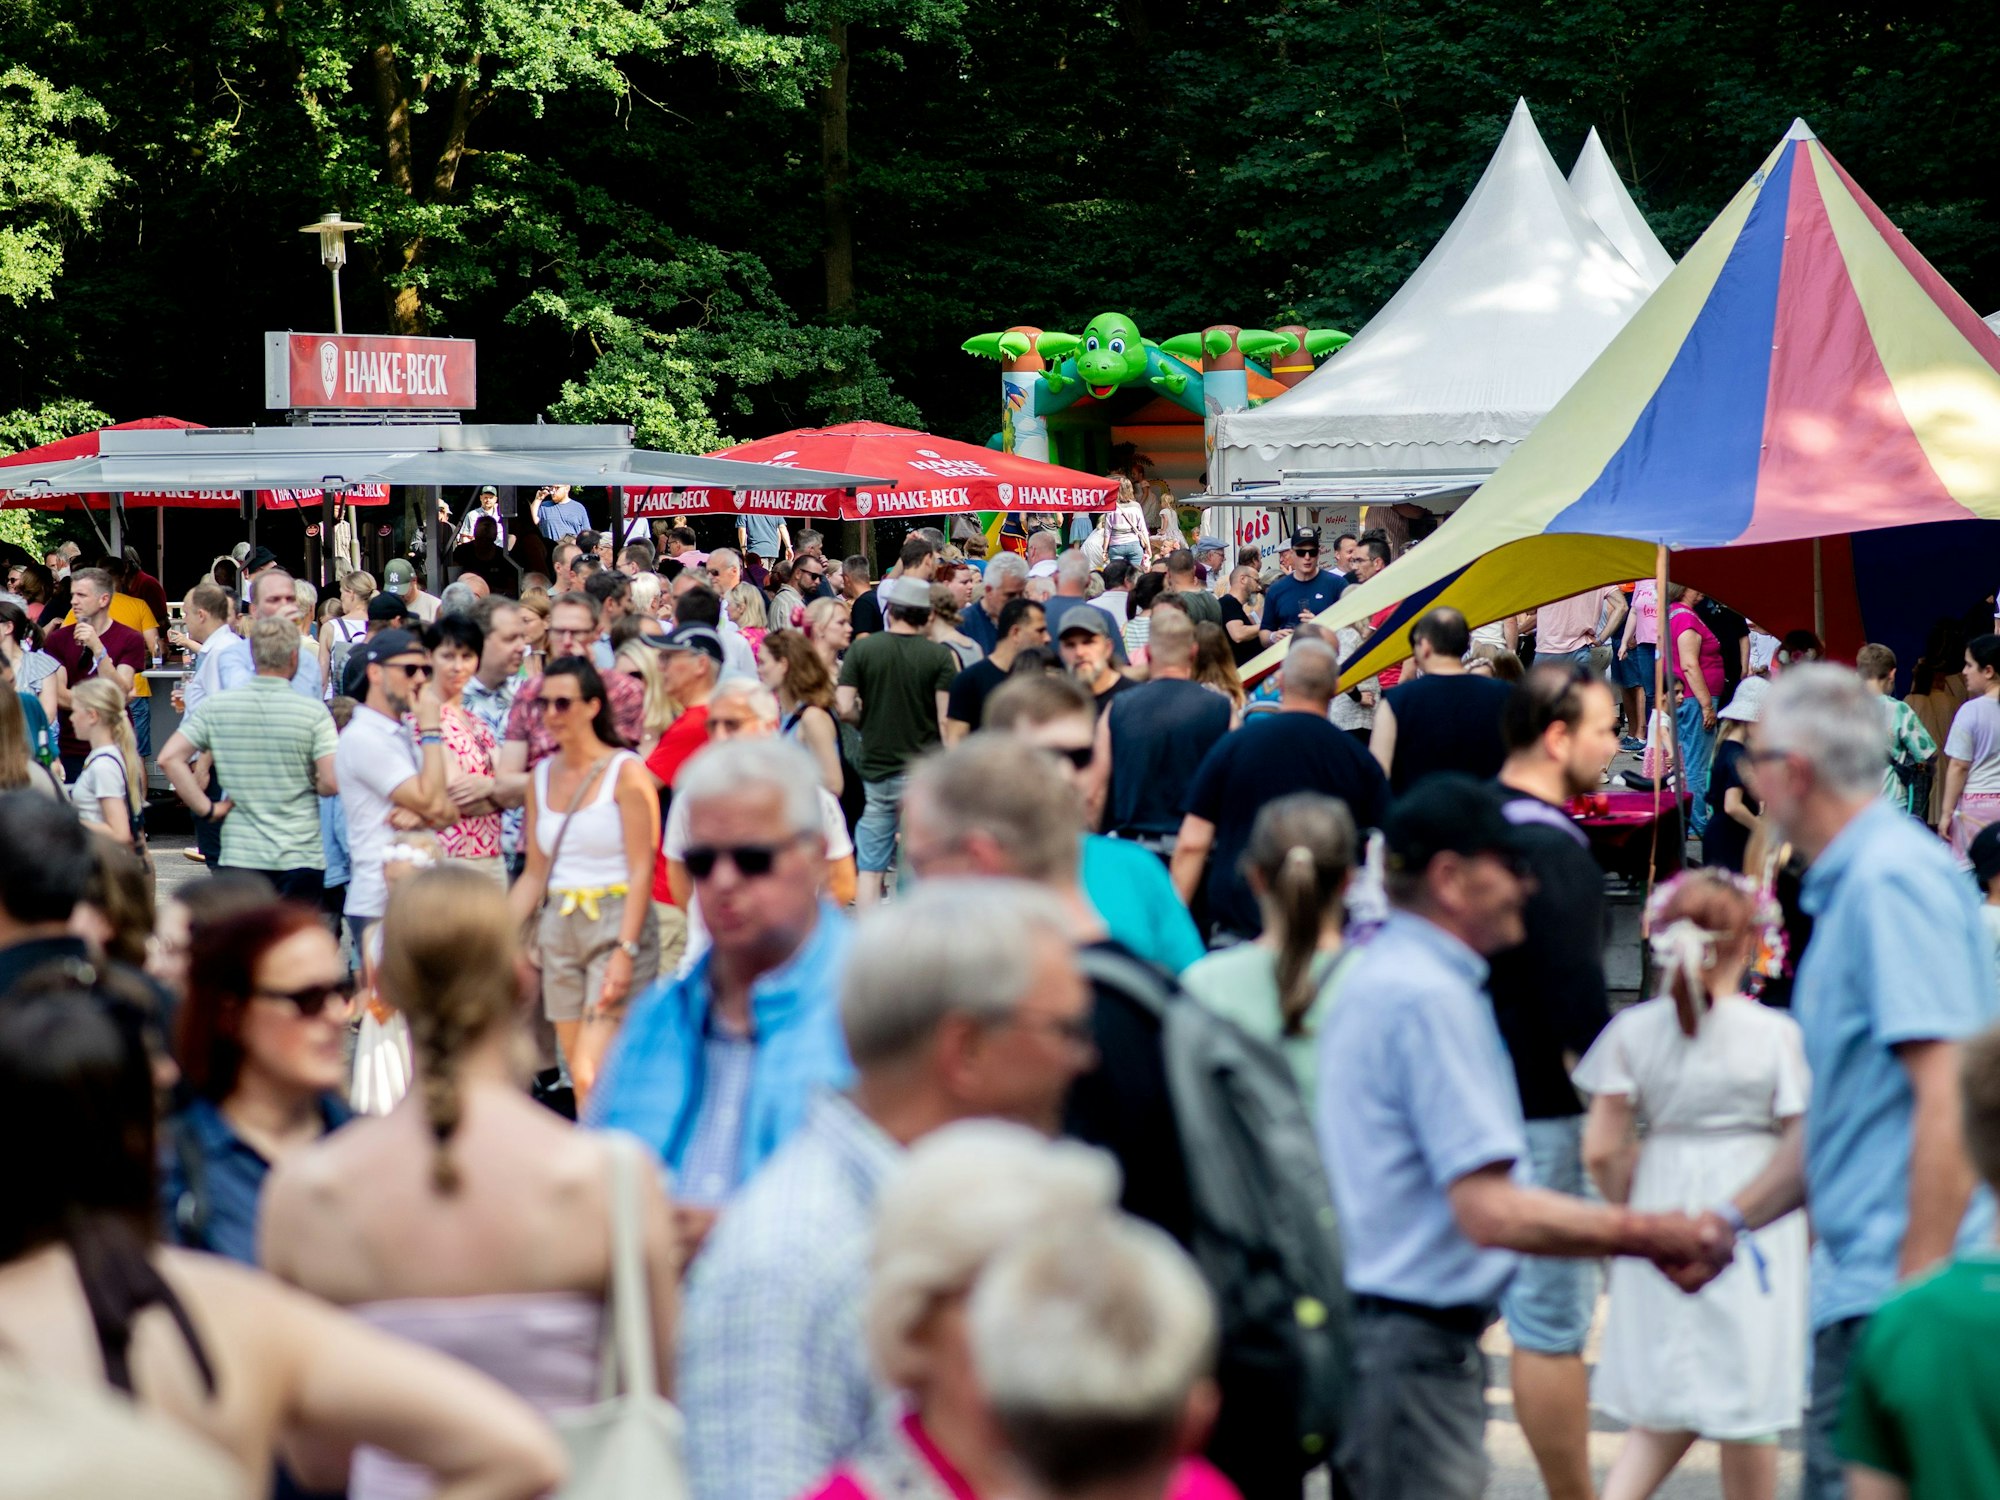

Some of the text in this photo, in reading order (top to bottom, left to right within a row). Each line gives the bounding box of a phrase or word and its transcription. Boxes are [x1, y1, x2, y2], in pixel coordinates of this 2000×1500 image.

[345, 350, 448, 396] HAAKE-BECK
[906, 459, 988, 470] HAAKE
[633, 489, 710, 512] HAAKEBECK
[750, 490, 828, 512] HAAKE-BECK
[876, 487, 971, 512] HAAKE-BECK
[1018, 486, 1109, 506] HAAKE-BECK
